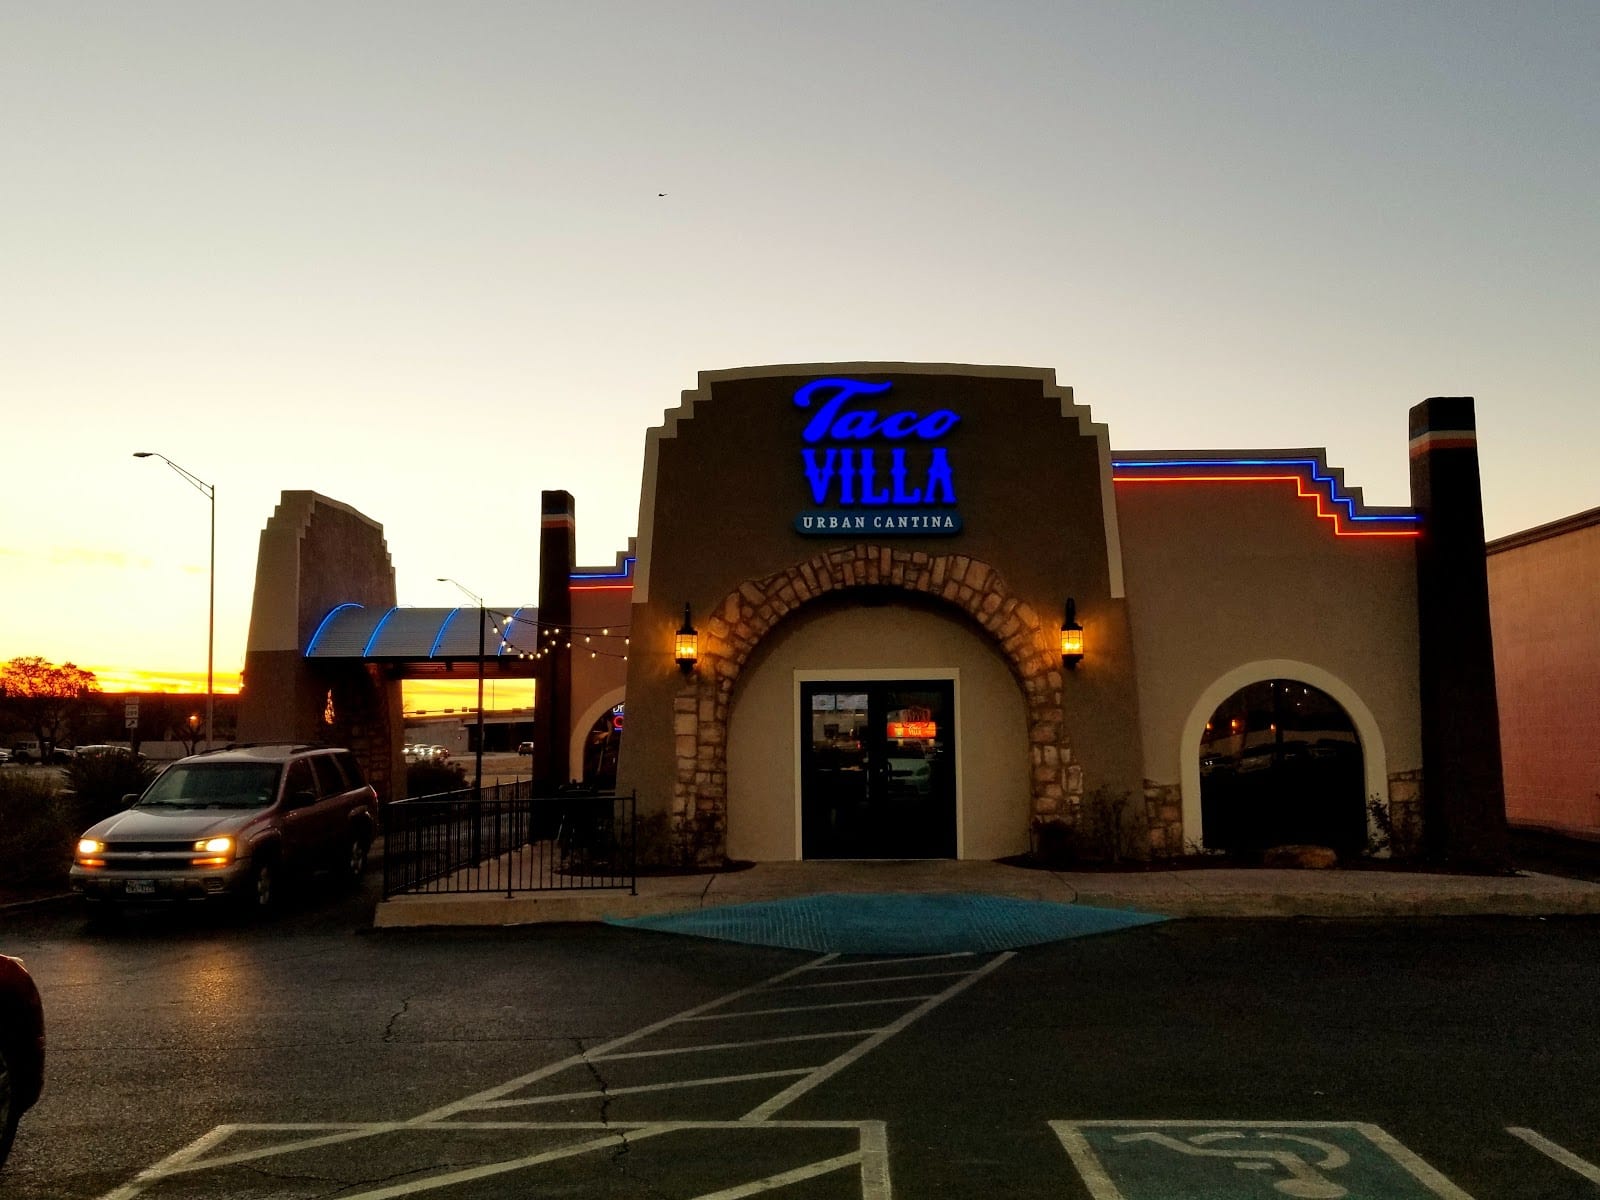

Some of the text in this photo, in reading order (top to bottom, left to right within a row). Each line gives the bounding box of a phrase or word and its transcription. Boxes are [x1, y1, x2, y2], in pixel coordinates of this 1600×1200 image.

[793, 377, 961, 442] Taco
[801, 447, 956, 504] VILLA
[803, 517, 953, 528] URBAN CANTINA
